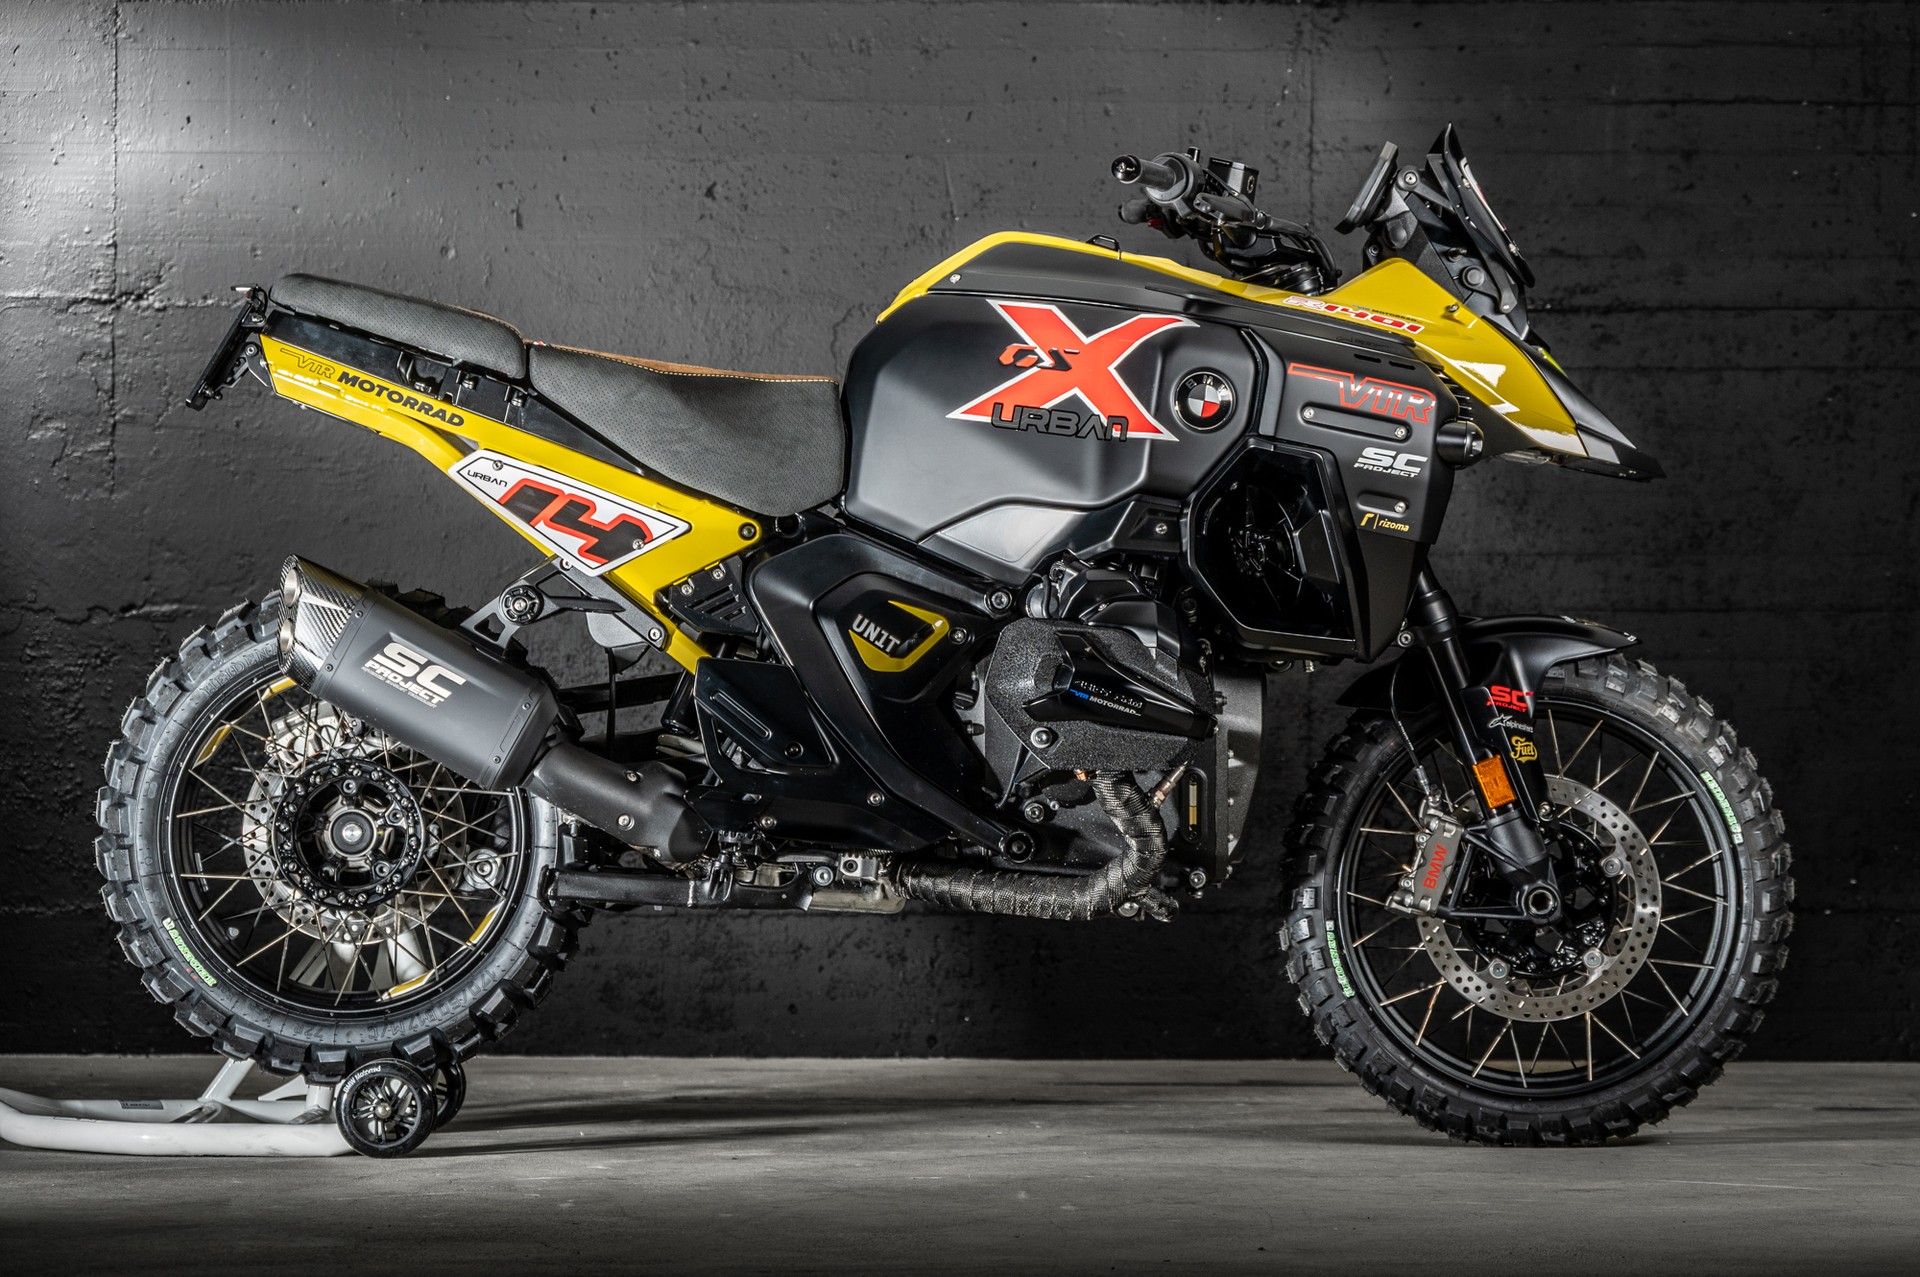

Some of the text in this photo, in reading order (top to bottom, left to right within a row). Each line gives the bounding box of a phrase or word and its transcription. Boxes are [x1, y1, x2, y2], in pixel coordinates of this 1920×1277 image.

[337, 370, 465, 427] MOTORRAD
[991, 402, 1129, 442] URBAN
[466, 469, 508, 488] URBAN
[1353, 462, 1419, 478] PROJECT
[1357, 447, 1429, 473] SC
[1378, 518, 1410, 532] rizoma
[852, 613, 901, 653] UNIT
[203, 643, 278, 696] HEIDEN
[364, 659, 445, 704] PROJECT
[372, 642, 467, 699] SC
[1089, 695, 1137, 715] MOTORRAD
[1489, 685, 1534, 708] SC
[1423, 842, 1448, 890] BMW
[168, 928, 218, 987] HEIDENAU
[342, 1077, 356, 1094] BMW
